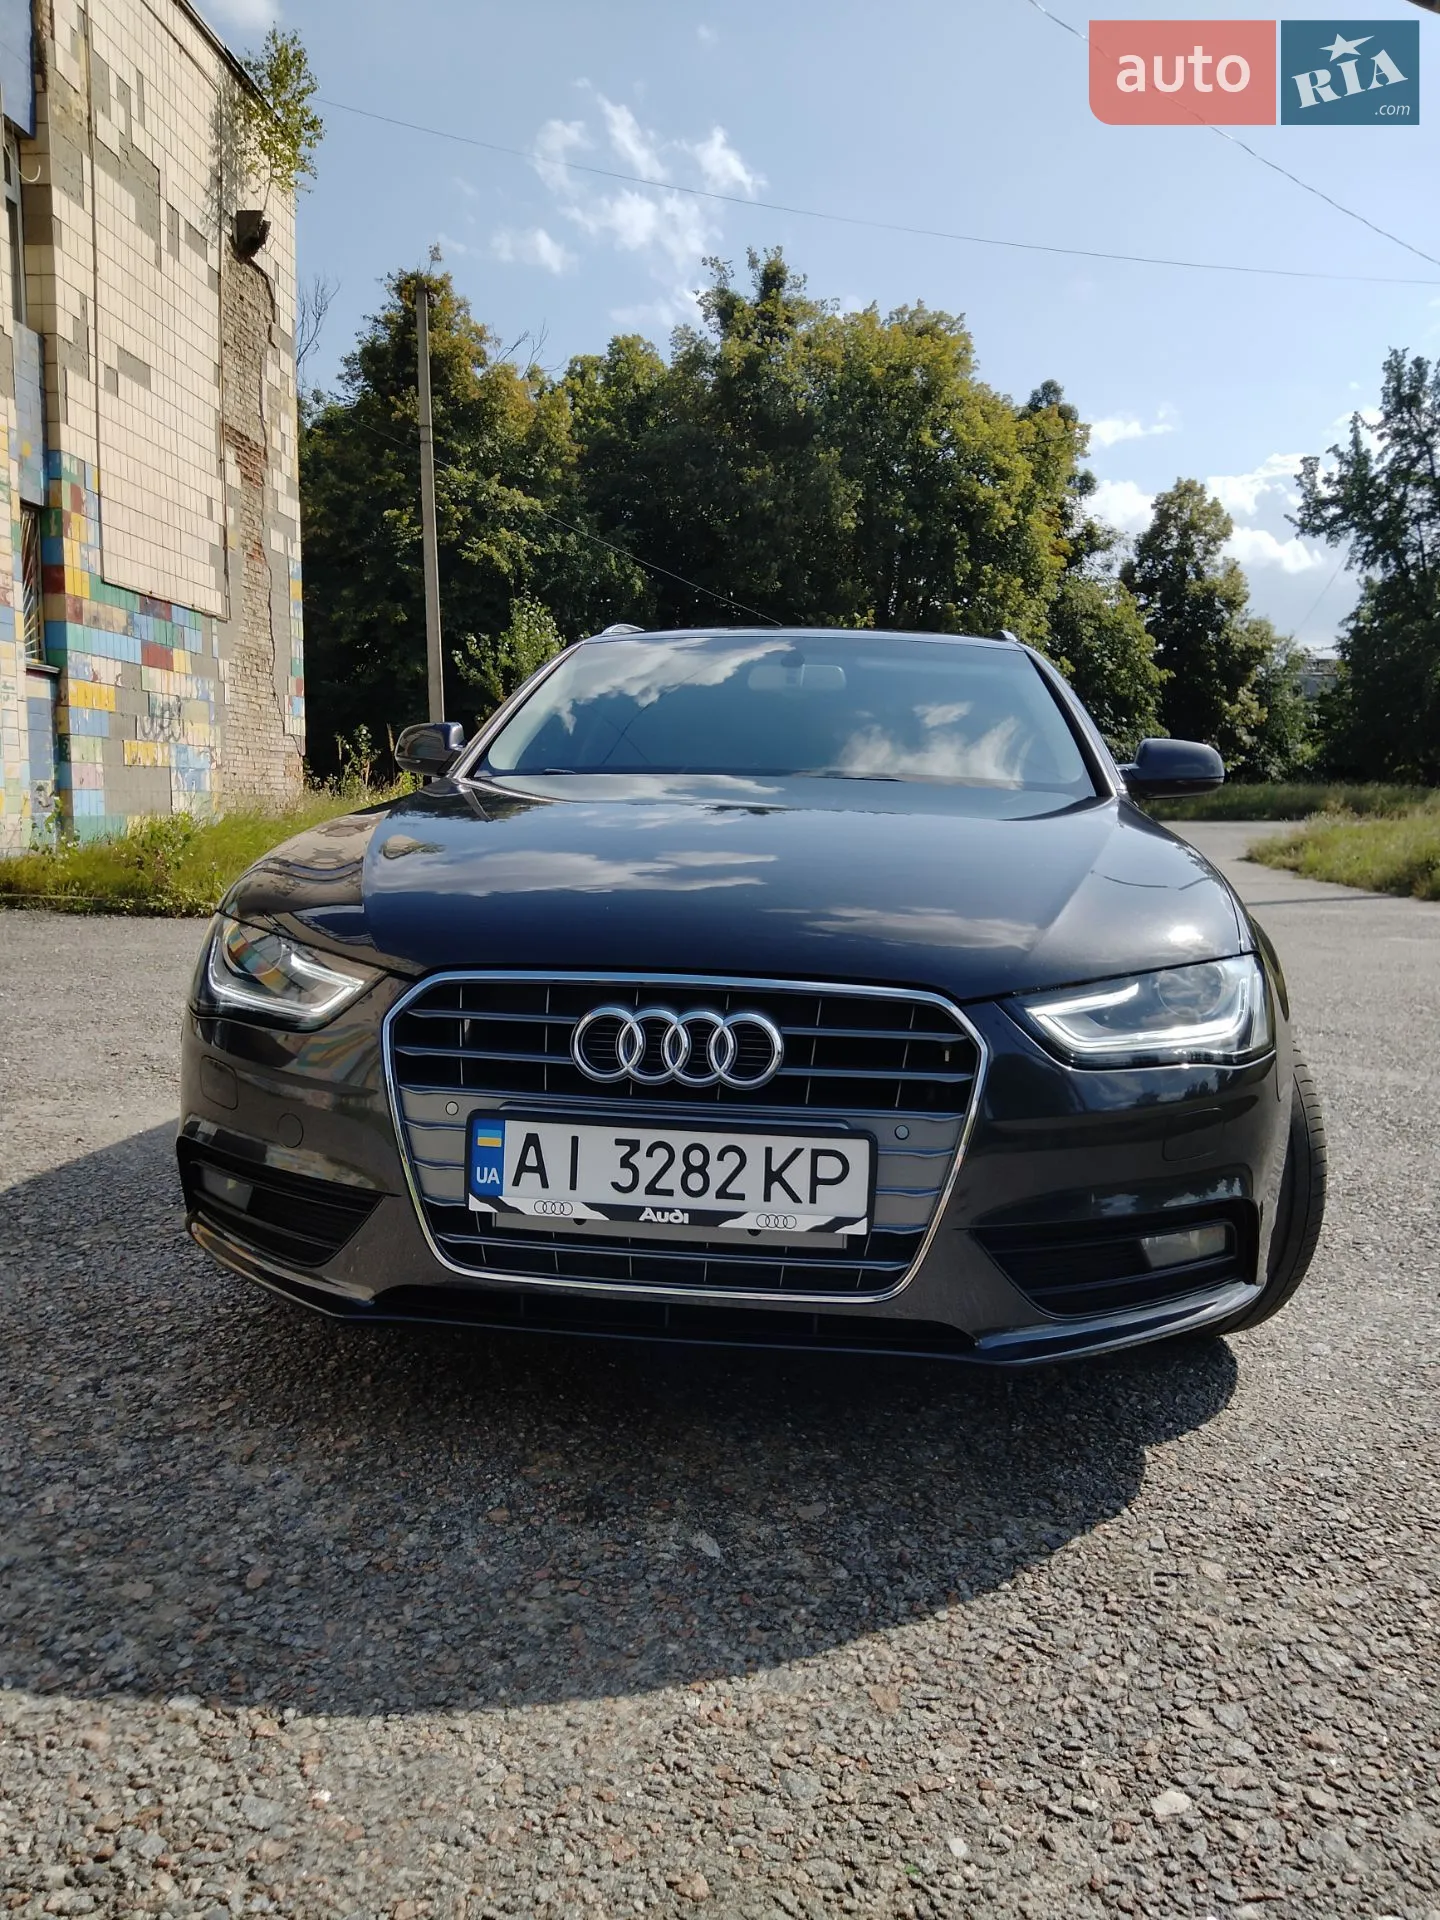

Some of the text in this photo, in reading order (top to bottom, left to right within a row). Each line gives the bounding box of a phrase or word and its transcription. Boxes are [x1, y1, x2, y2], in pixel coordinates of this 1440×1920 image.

[476, 1166, 500, 1184] UA
[511, 1132, 851, 1204] AI 3282 KP
[638, 1206, 690, 1224] Audi
